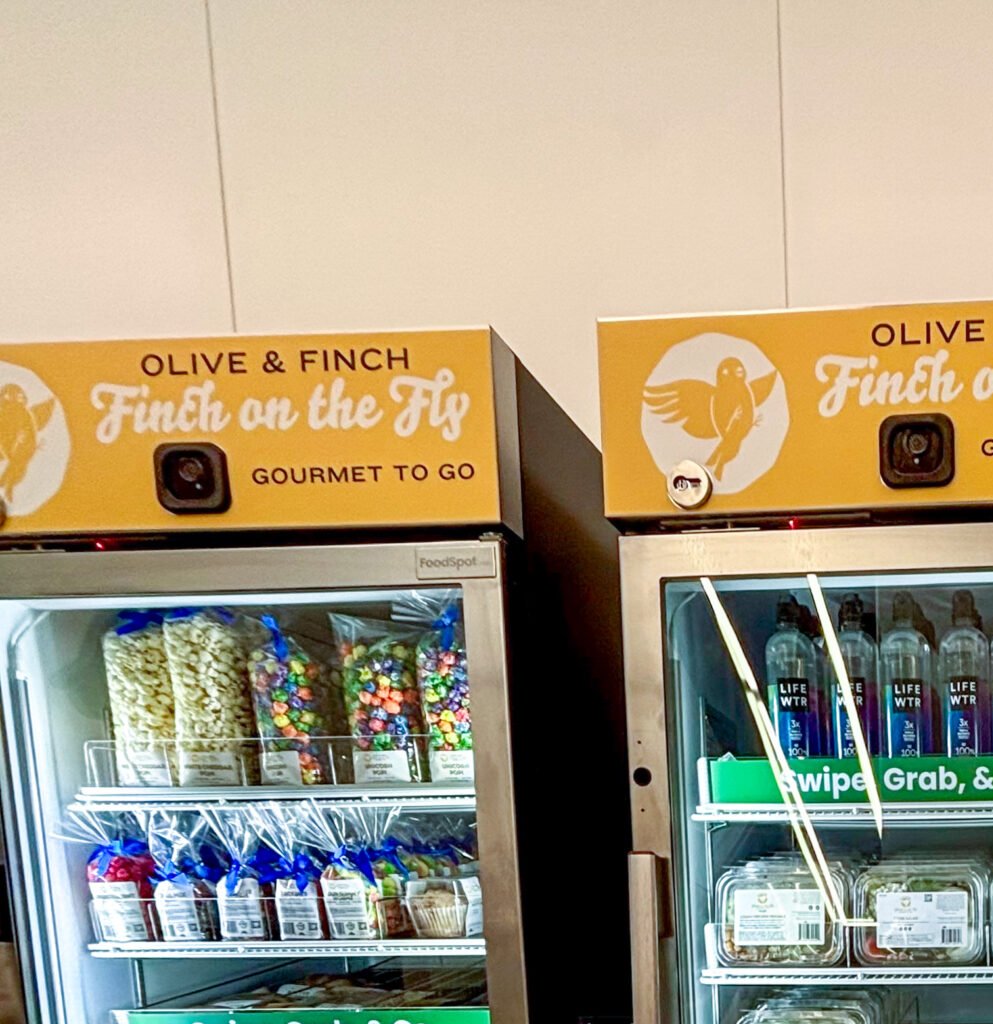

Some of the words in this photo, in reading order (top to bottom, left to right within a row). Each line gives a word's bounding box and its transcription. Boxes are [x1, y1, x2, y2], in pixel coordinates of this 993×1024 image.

[871, 320, 986, 347] OLIVE
[140, 352, 248, 377] OLIVE
[262, 350, 286, 373] &
[299, 347, 411, 371] FINCH
[814, 349, 964, 418] Finch
[89, 379, 231, 444] Finch
[238, 404, 299, 430] on
[307, 382, 384, 428] the
[388, 367, 470, 442] Fly
[251, 467, 382, 484] GOURMET
[392, 465, 430, 481] TO
[438, 463, 476, 480] GO
[419, 556, 477, 571] FoodSpot
[780, 683, 806, 694] LIFE
[895, 684, 921, 694] LIFE
[950, 682, 976, 692] LIFE
[780, 696, 808, 706] WTR
[895, 697, 921, 707] WTR
[950, 695, 976, 705] WTR
[883, 766, 965, 794] Grab,
